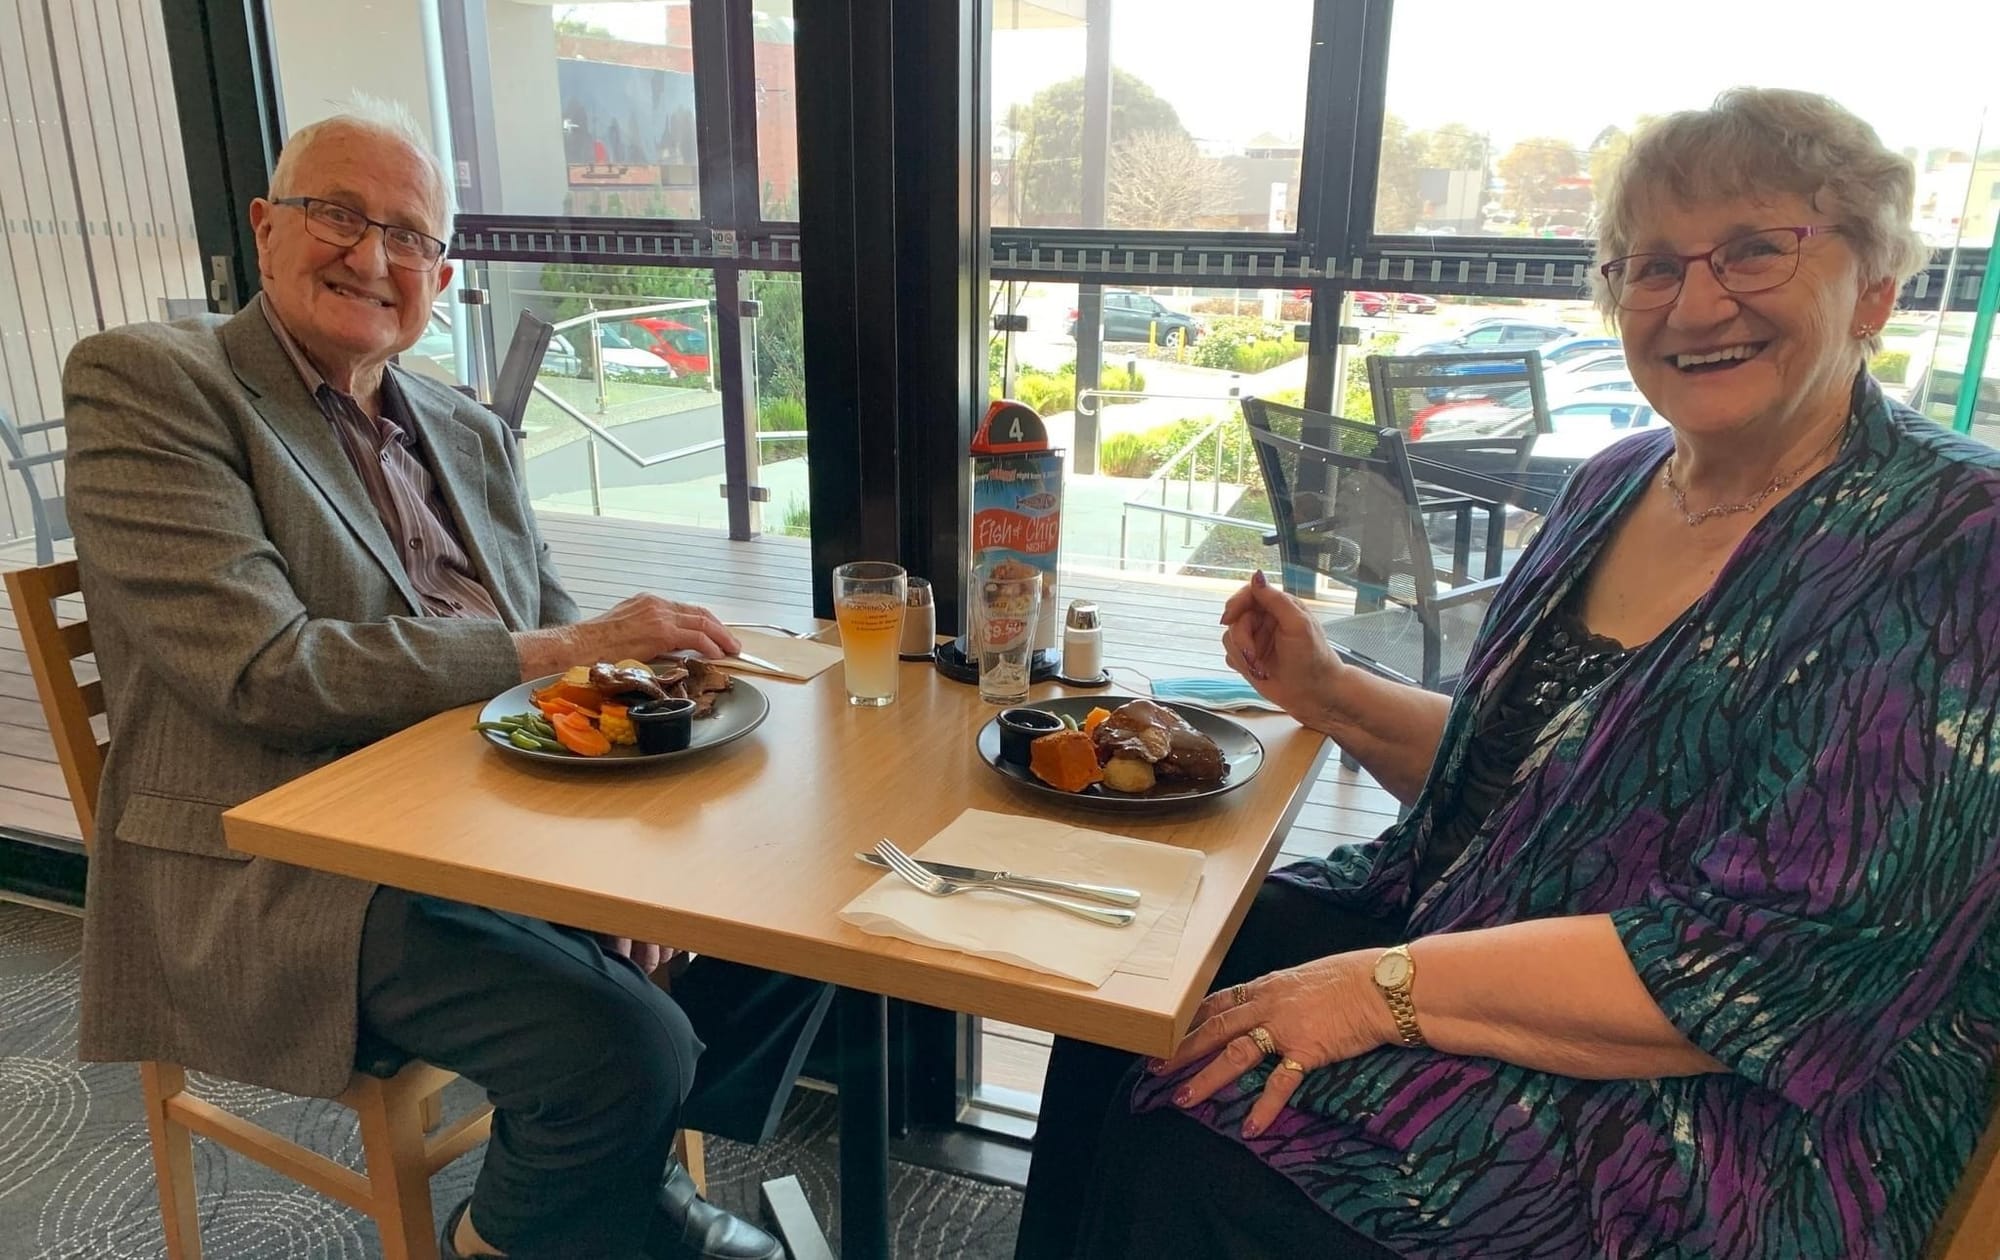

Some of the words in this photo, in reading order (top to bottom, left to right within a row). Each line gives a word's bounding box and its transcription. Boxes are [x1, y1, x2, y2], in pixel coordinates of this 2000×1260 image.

[1008, 416, 1024, 442] 4
[978, 517, 1012, 547] Fish
[1025, 516, 1058, 546] Chip
[1026, 540, 1047, 553] NIGHT
